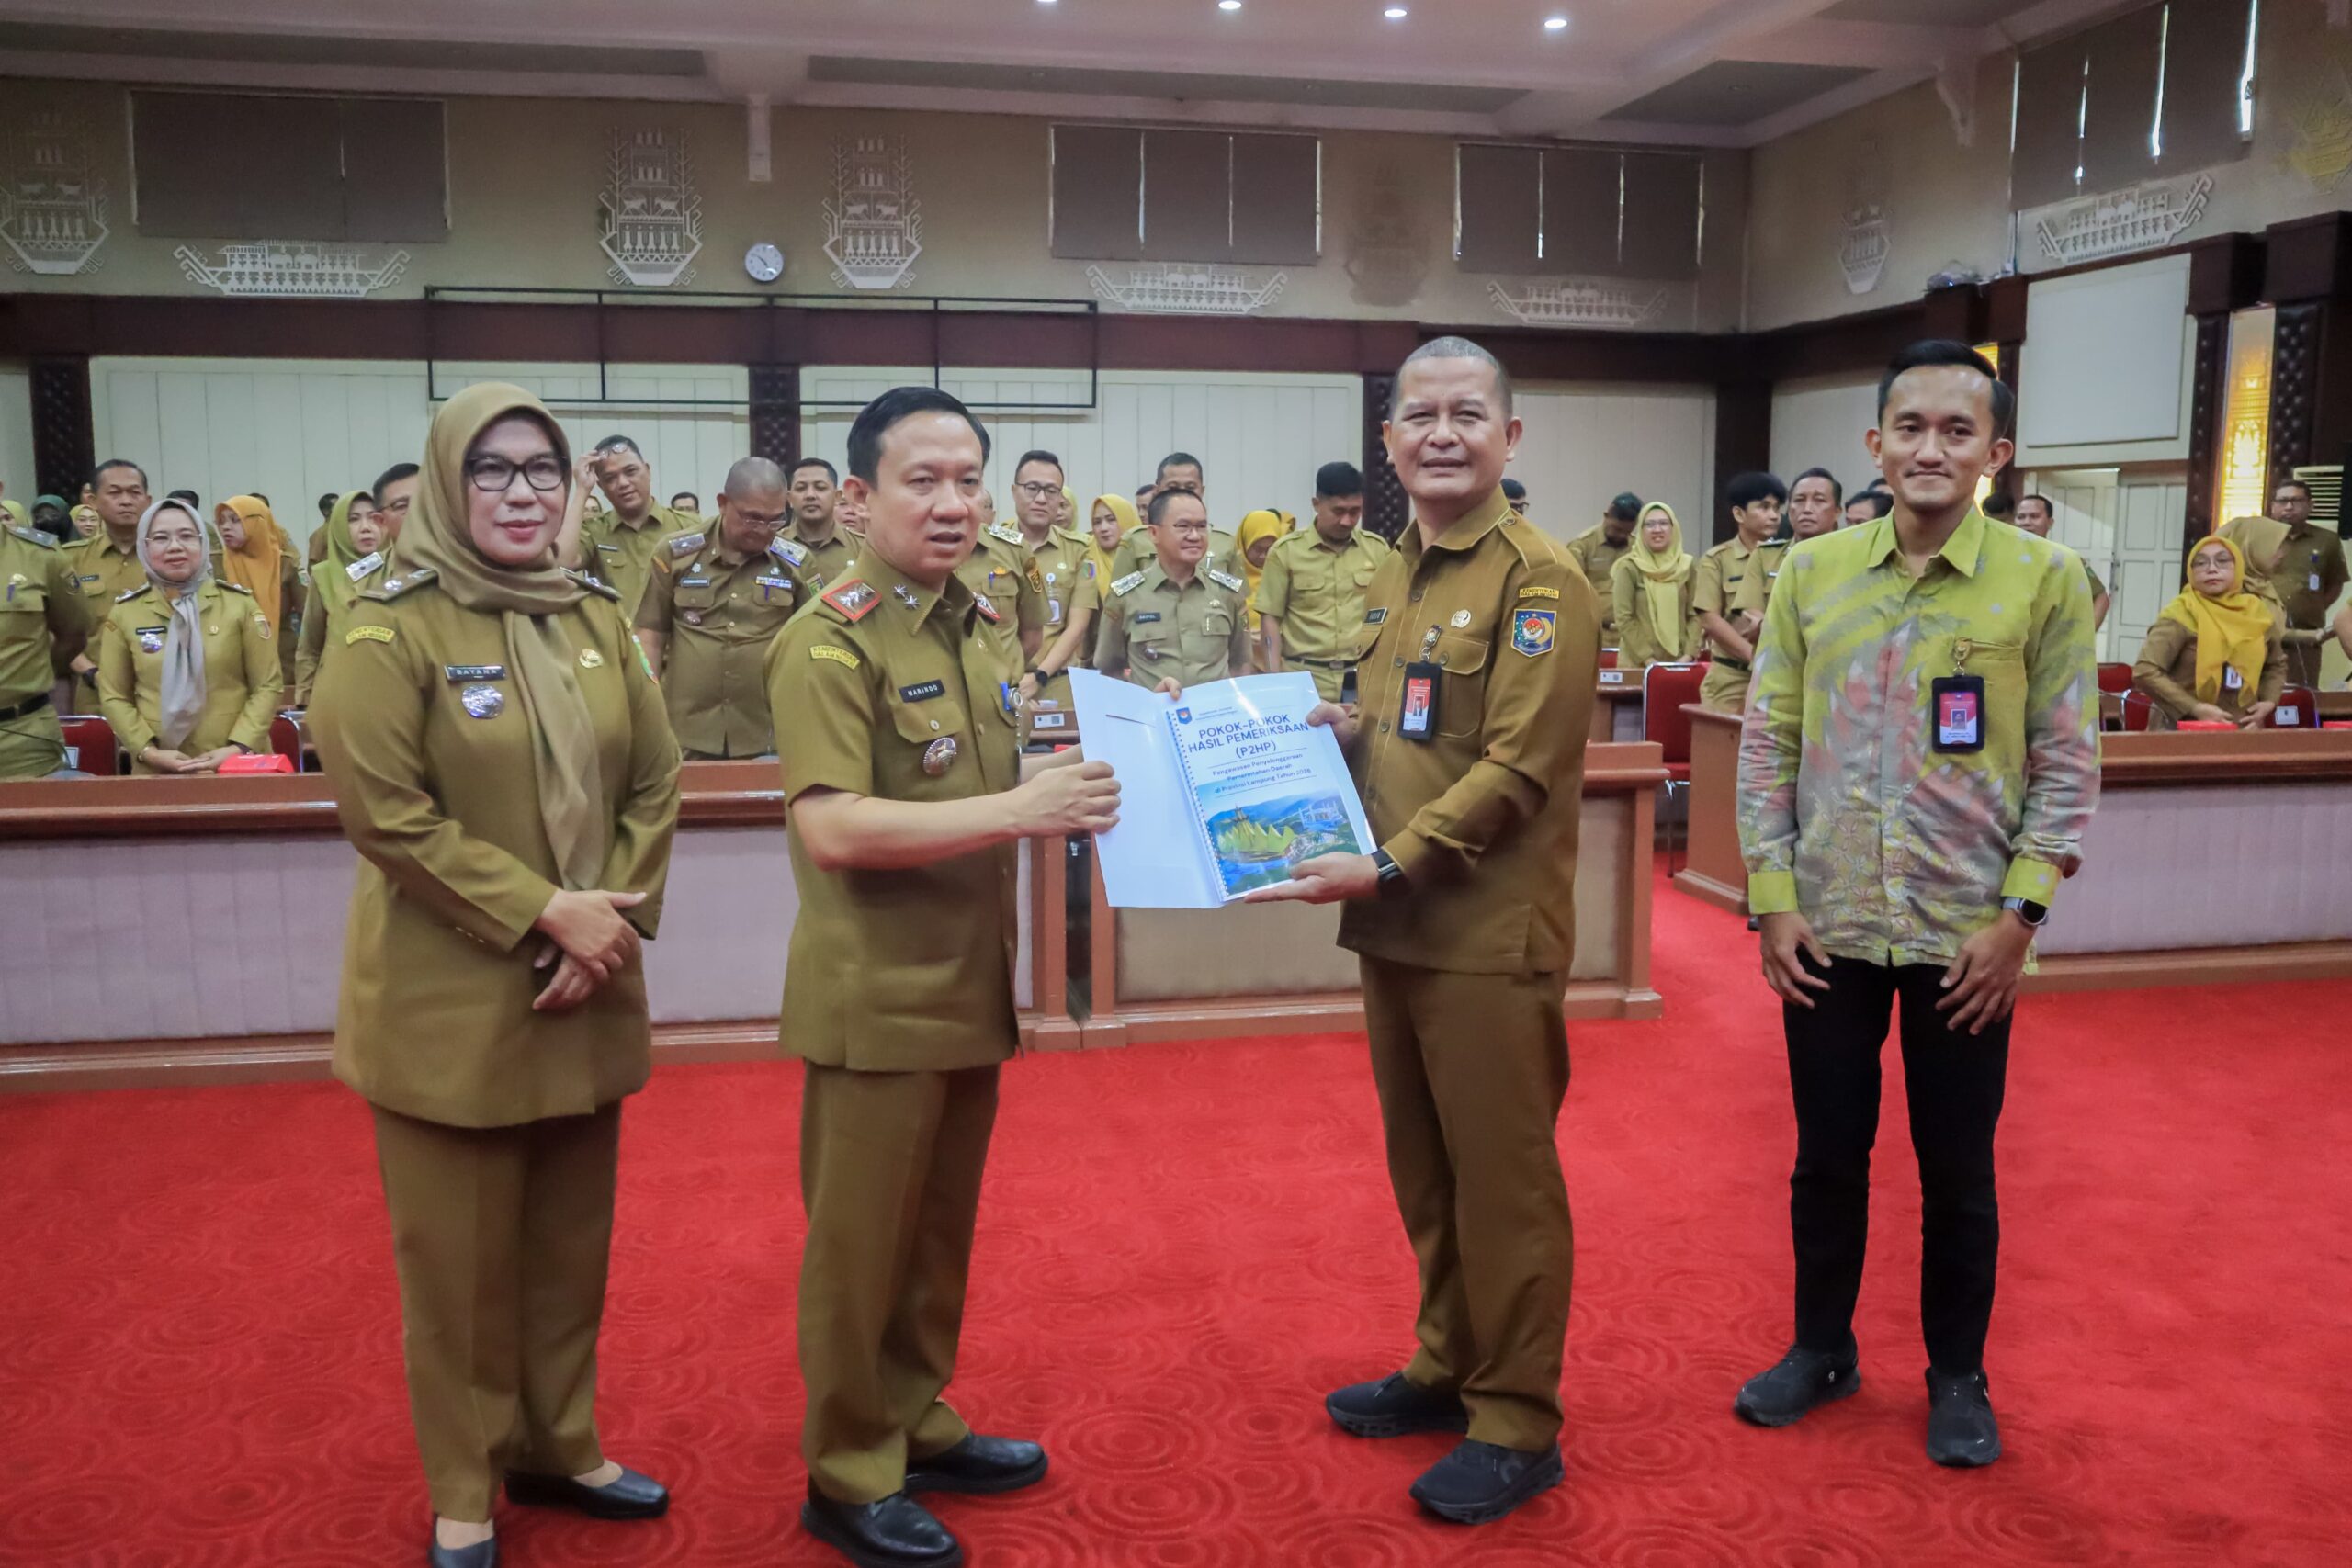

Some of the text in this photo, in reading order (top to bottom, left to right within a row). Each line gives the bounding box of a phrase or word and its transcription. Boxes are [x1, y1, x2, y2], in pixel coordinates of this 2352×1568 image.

[907, 684, 938, 696] MARINDO
[1199, 714, 1291, 739] POKOK-POKOK
[1188, 722, 1309, 753] HASIL PEMERIKSAAN
[1236, 740, 1276, 759] (P2HP)
[1212, 763, 1250, 776] Pengawasan
[1271, 763, 1293, 772] Daerah
[1222, 782, 1247, 792] Provinsi
[1247, 775, 1276, 786] Lampung
